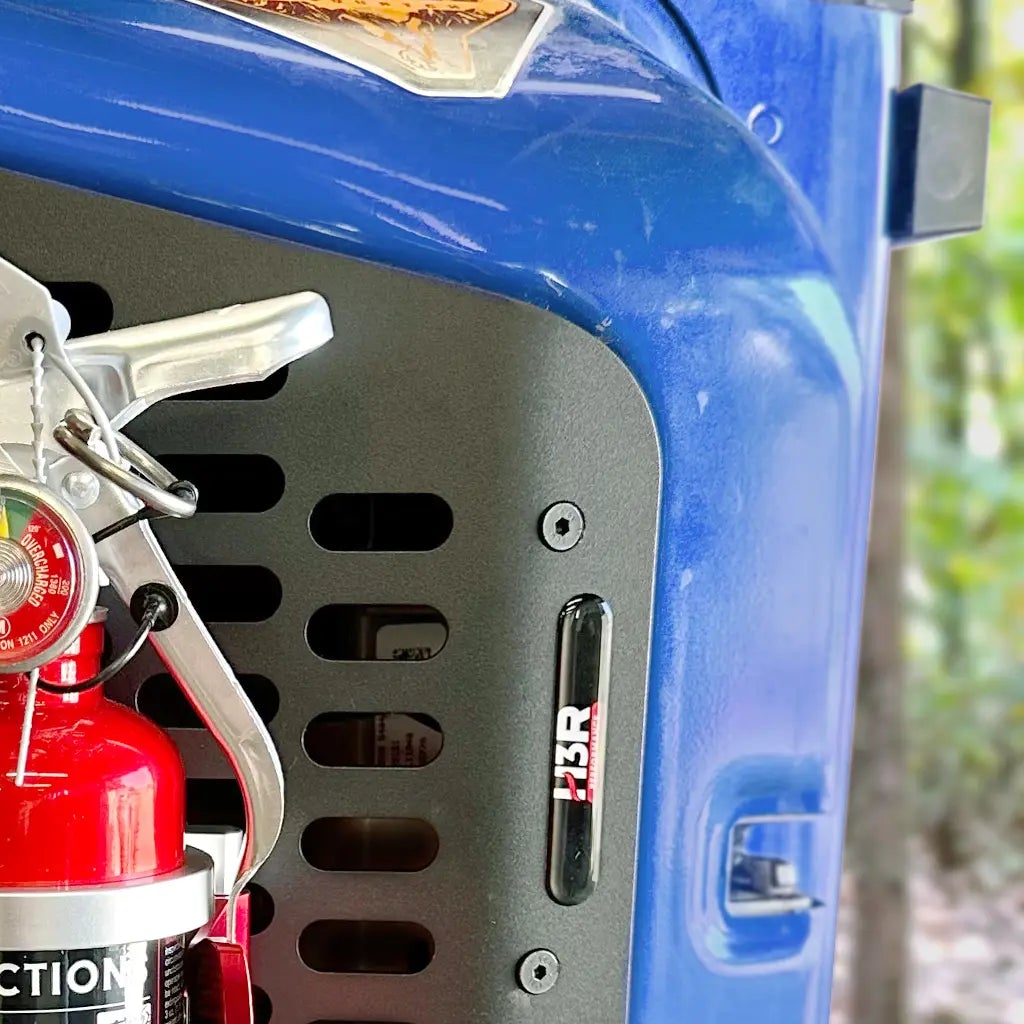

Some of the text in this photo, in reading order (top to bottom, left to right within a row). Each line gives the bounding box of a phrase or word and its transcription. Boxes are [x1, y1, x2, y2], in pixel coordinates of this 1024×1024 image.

[20, 533, 49, 608] OVERCHARGED
[18, 631, 38, 647] 1211
[38, 610, 59, 634] ONLY
